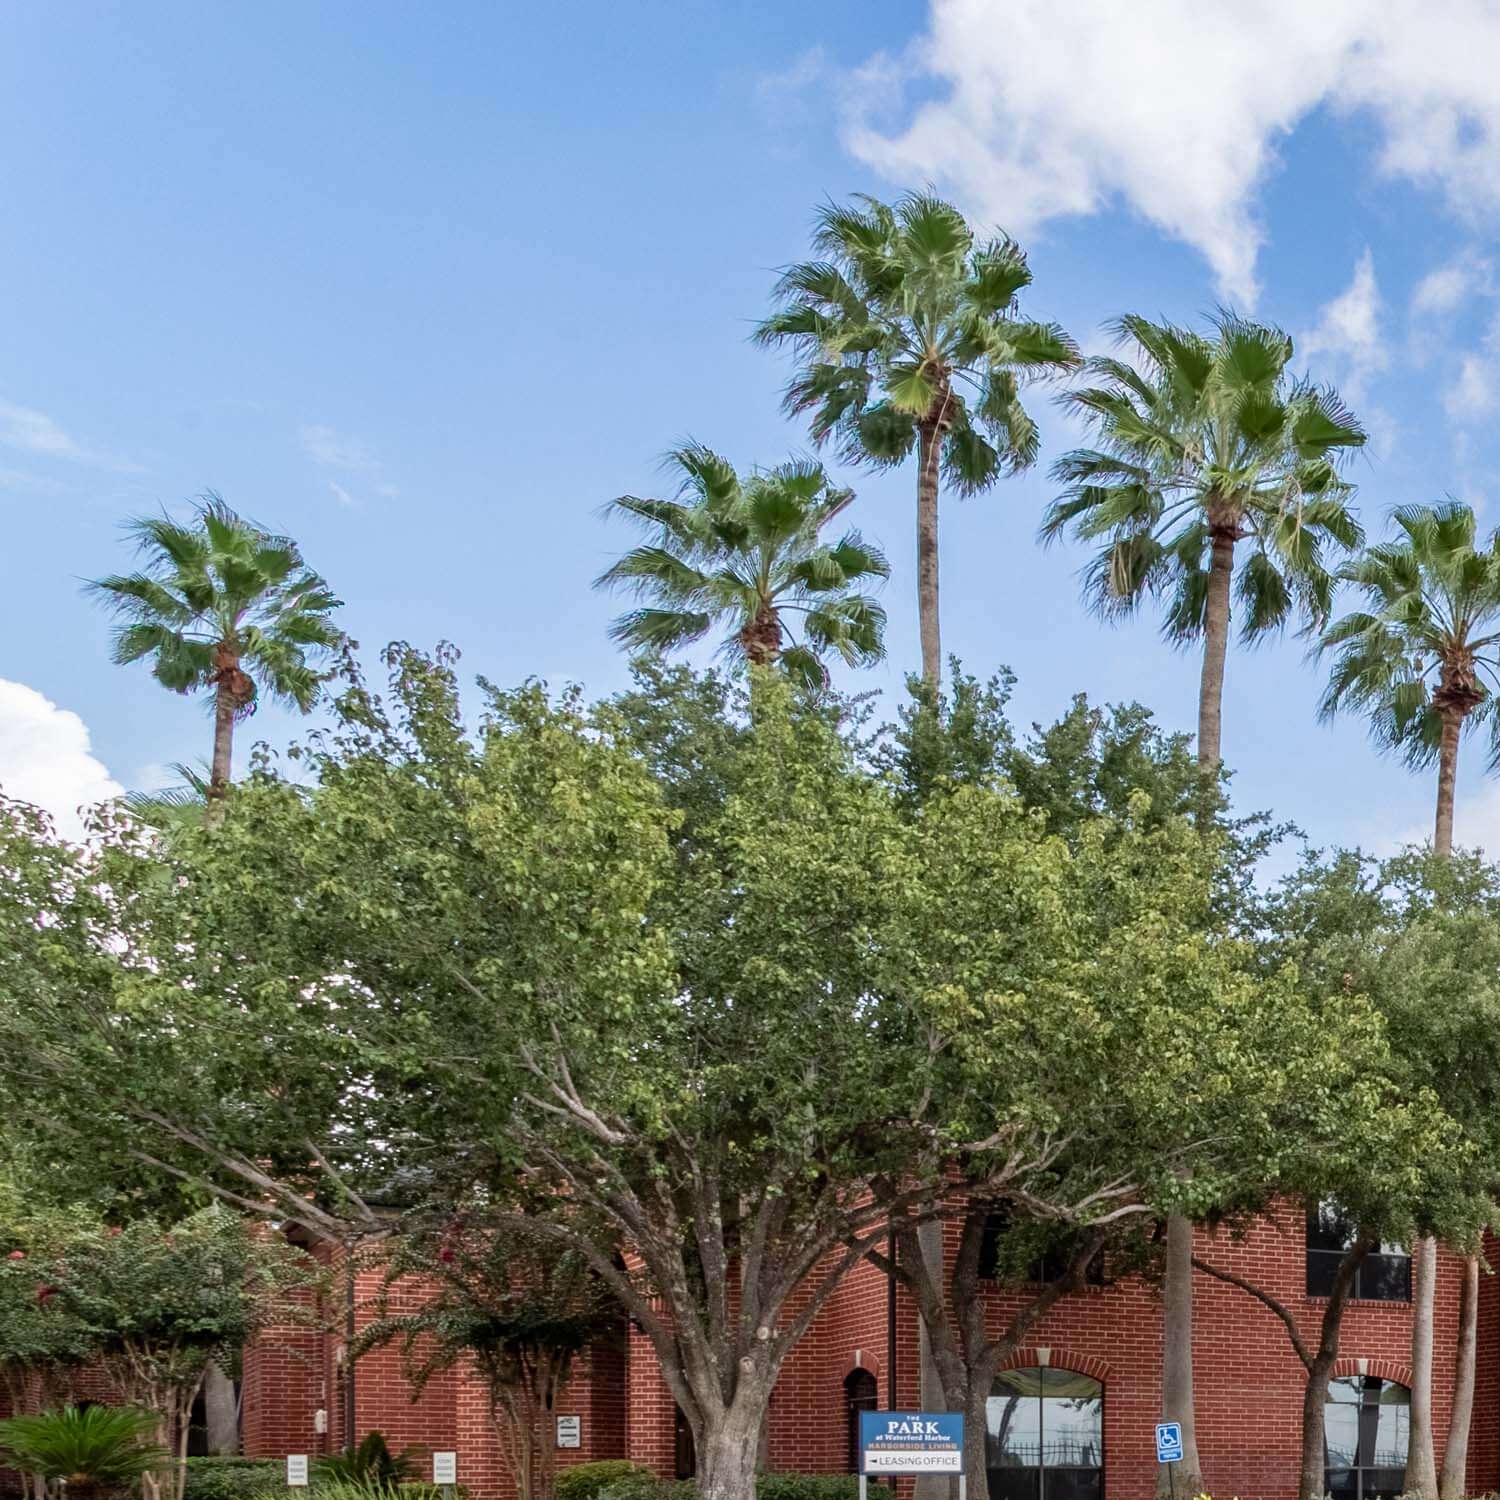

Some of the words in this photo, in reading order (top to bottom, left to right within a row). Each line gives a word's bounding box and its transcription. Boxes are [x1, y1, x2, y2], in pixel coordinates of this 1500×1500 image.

[887, 1421, 939, 1434] PARK
[879, 1457, 922, 1466] LEASING
[923, 1457, 958, 1466] OFFICE
